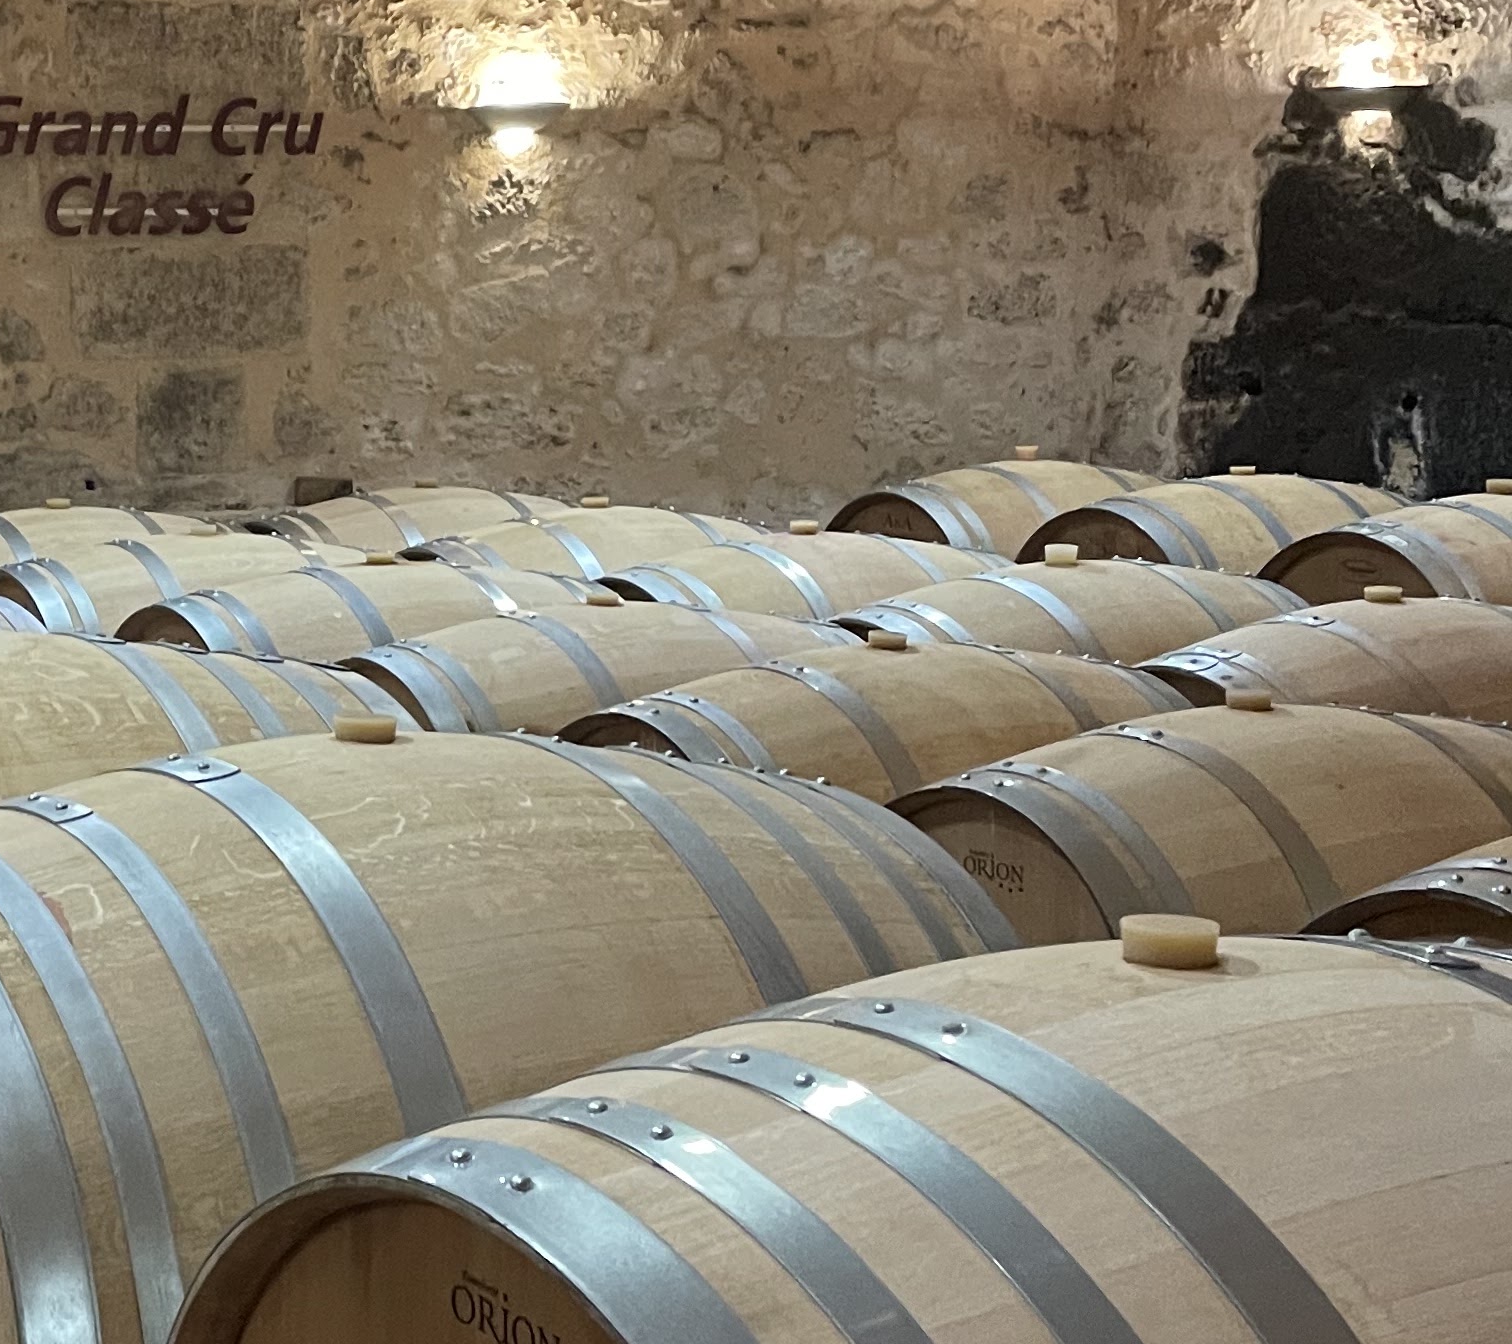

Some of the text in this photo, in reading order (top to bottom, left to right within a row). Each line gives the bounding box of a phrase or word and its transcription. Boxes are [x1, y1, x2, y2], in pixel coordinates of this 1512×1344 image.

[209, 96, 323, 158] Cru
[44, 173, 255, 236] Classé
[963, 853, 1024, 884] ORION
